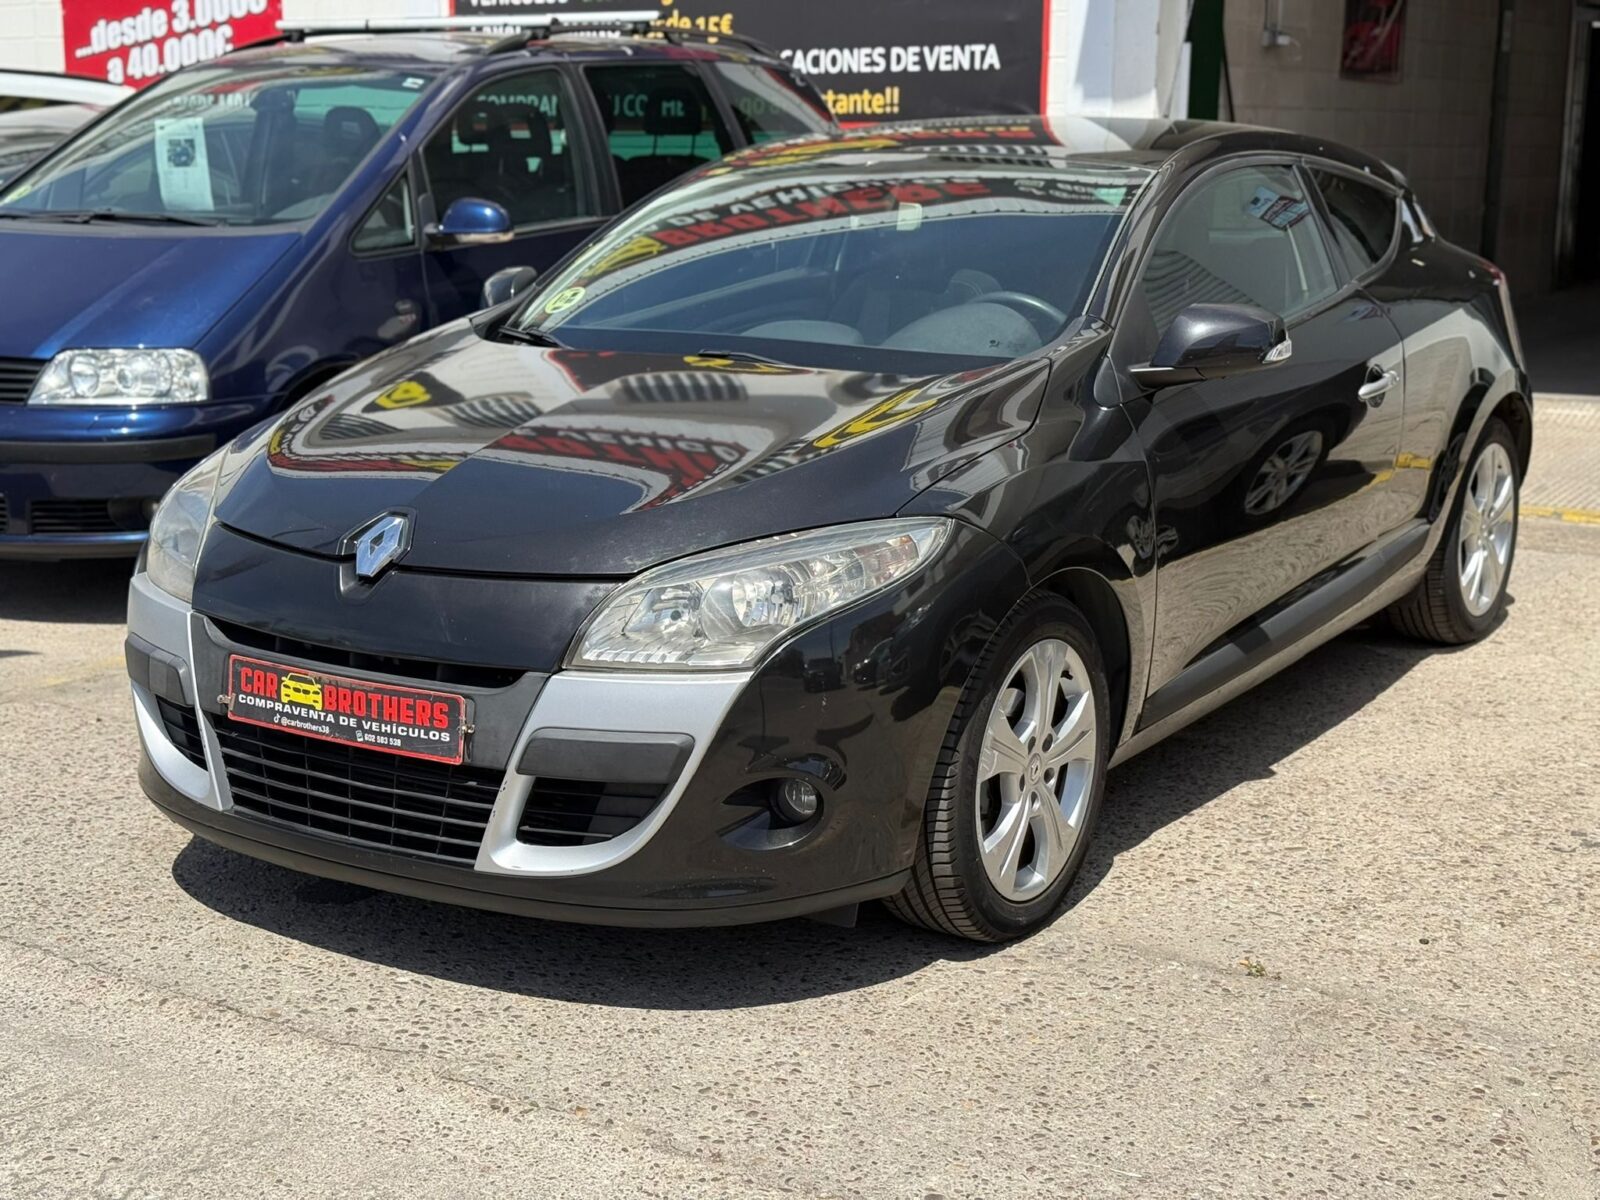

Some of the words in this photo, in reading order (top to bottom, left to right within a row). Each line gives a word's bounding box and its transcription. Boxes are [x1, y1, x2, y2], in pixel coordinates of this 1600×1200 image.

[75, 7, 168, 58] ...desde
[107, 57, 125, 84] a
[891, 46, 921, 73] DE
[922, 44, 1001, 72] VENTA
[822, 86, 900, 115] tante!!
[240, 667, 278, 699] CAR
[323, 684, 449, 729] BROTHERS
[238, 694, 336, 724] COMPRAVENTA
[340, 716, 358, 728] DE
[362, 720, 450, 742] VEHÍCULOS
